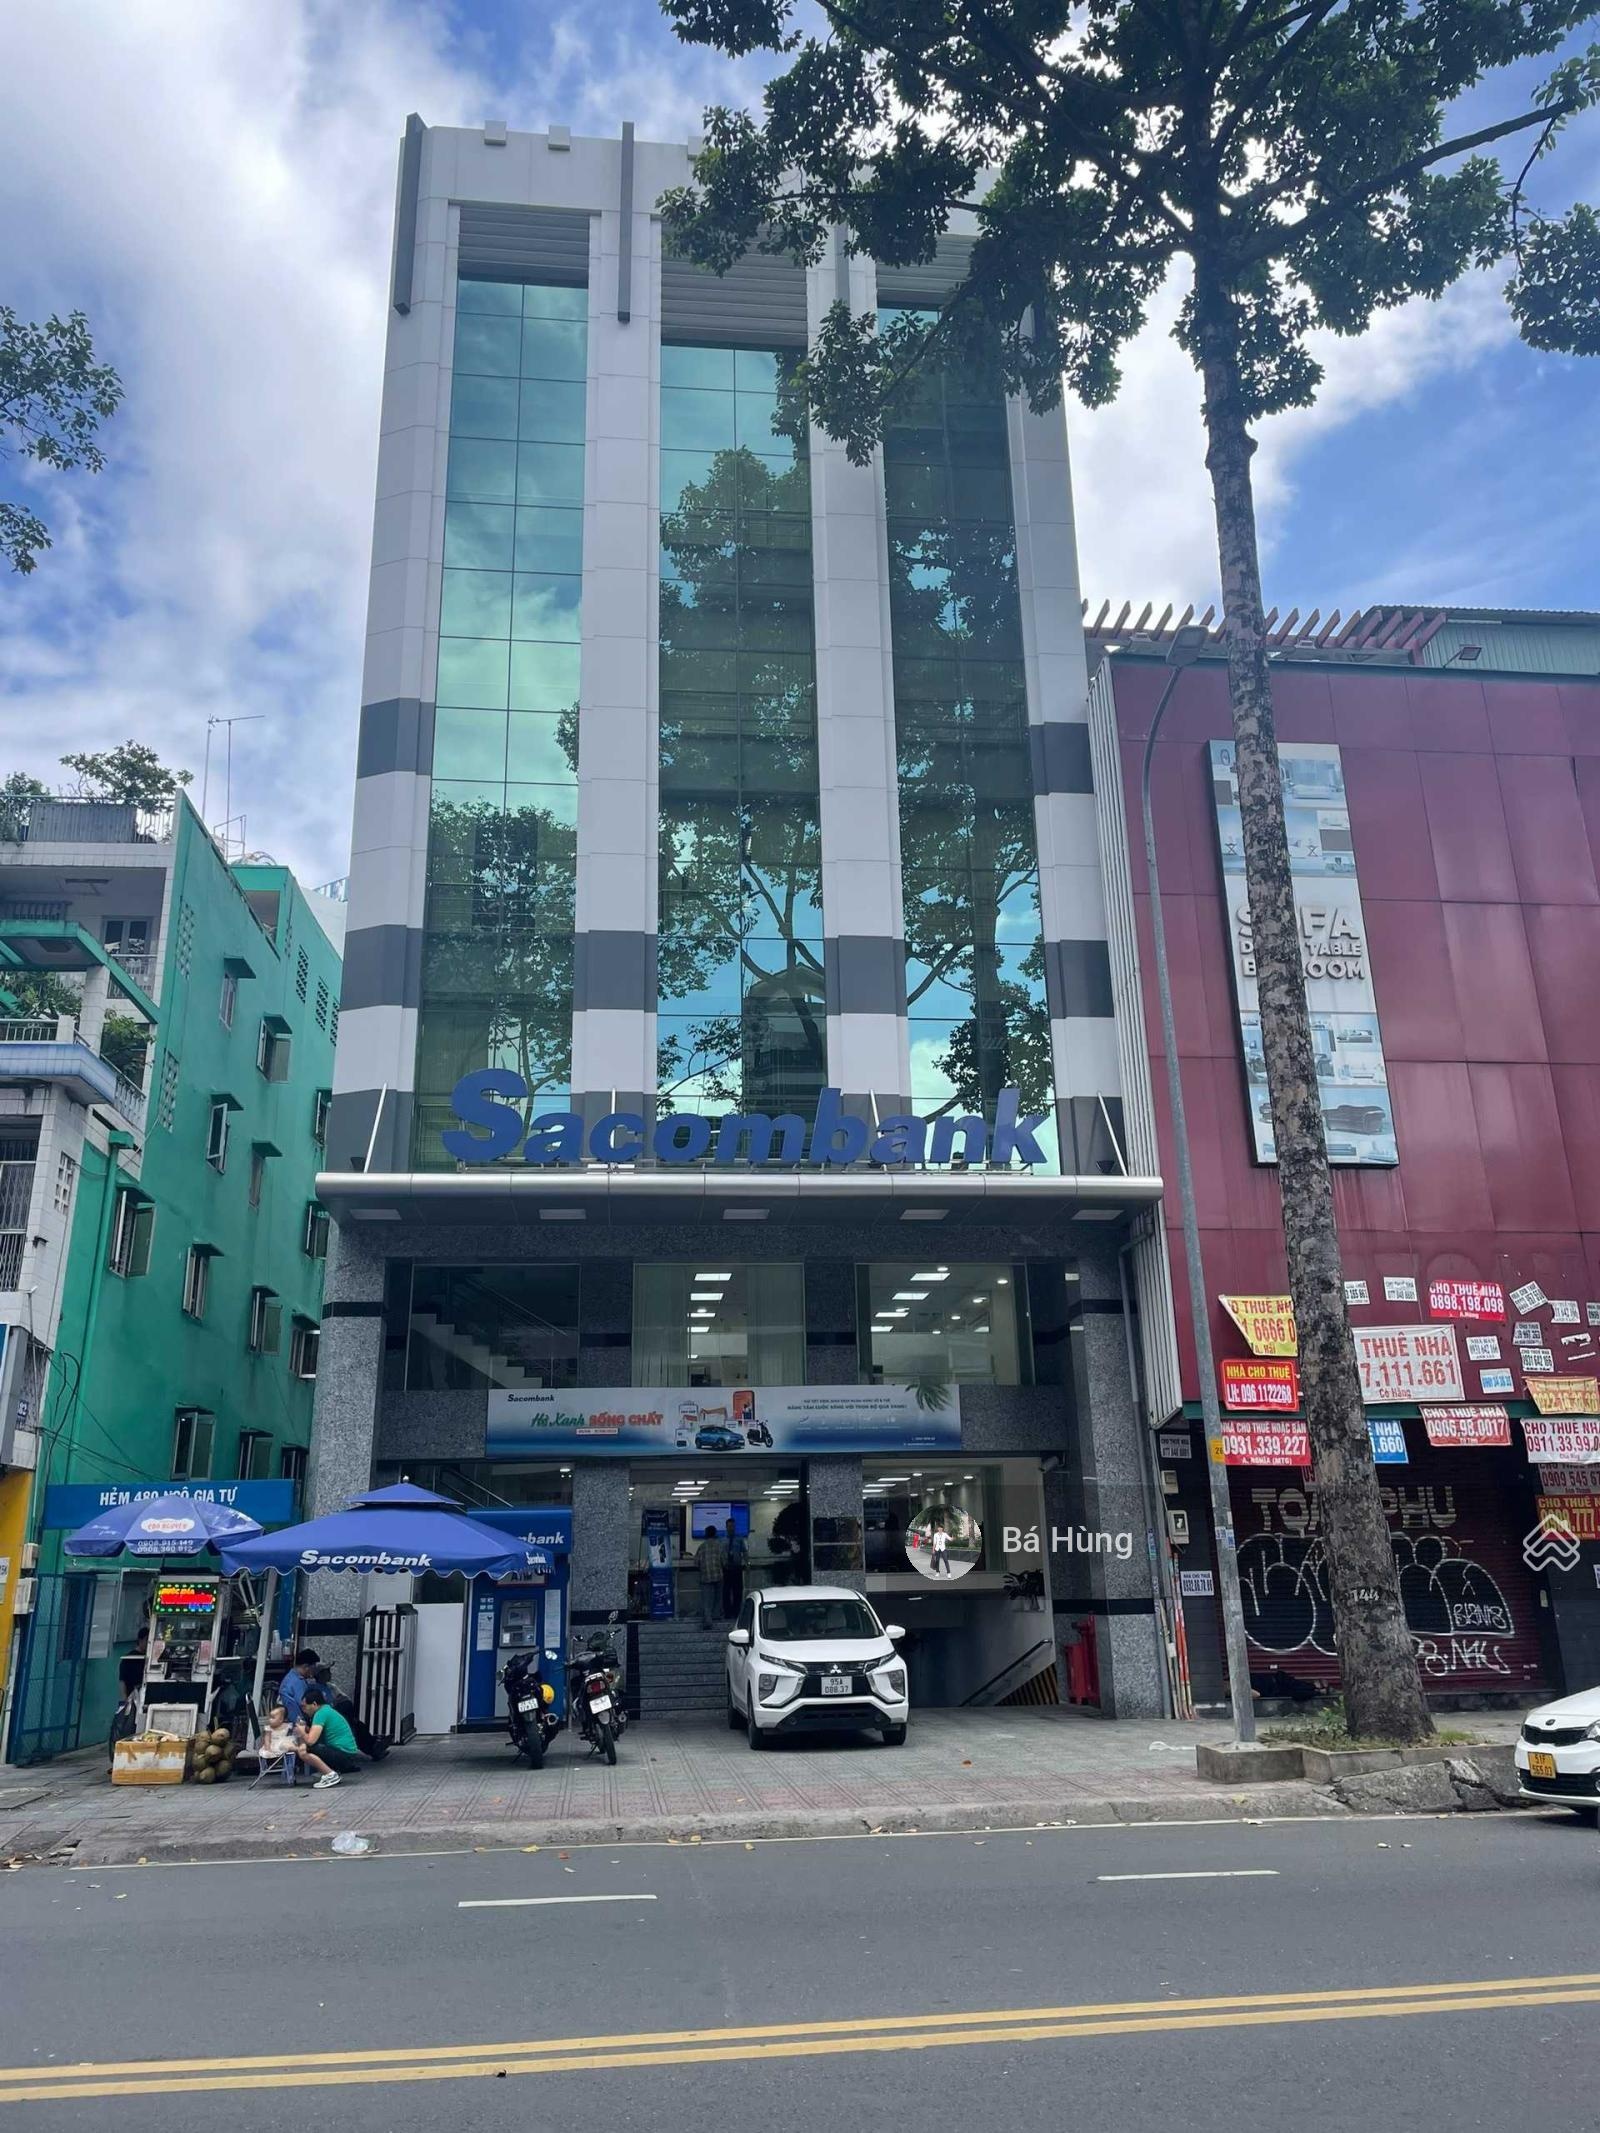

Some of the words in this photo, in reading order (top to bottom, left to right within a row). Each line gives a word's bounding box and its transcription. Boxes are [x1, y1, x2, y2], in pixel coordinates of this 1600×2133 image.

[1236, 905, 1360, 939] SFA
[1304, 941, 1361, 957] TABLE
[441, 1068, 1051, 1166] Sacombank
[1452, 1282, 1479, 1296] THUÊ
[1430, 1295, 1505, 1314] 0898.198.098
[1254, 1318, 1285, 1342] 6666
[1360, 1331, 1409, 1359] THUÊ
[1414, 1330, 1453, 1356] NHÀ
[1226, 1363, 1246, 1378] NHÀ
[1247, 1365, 1266, 1378] CHO
[1267, 1365, 1291, 1378] THUÊ
[1360, 1360, 1457, 1388] 7.111.661
[507, 1393, 555, 1402] Sacombank
[1226, 1383, 1241, 1403] LH:
[1240, 1383, 1257, 1403] 096
[550, 1412, 585, 1427] Xanh
[1423, 1407, 1447, 1418] CHO
[1450, 1405, 1477, 1418] THUÊ
[1236, 1421, 1252, 1434] CHO
[1252, 1420, 1271, 1434] THUÊ
[1524, 1422, 1547, 1434] CHO
[1222, 1435, 1307, 1455] 0931.339.227
[1541, 1471, 1567, 1487] 0909
[1568, 1471, 1588, 1487] 545
[100, 1487, 130, 1506] HẺM
[193, 1489, 215, 1503] GIA
[300, 1549, 433, 1567] Sacombank
